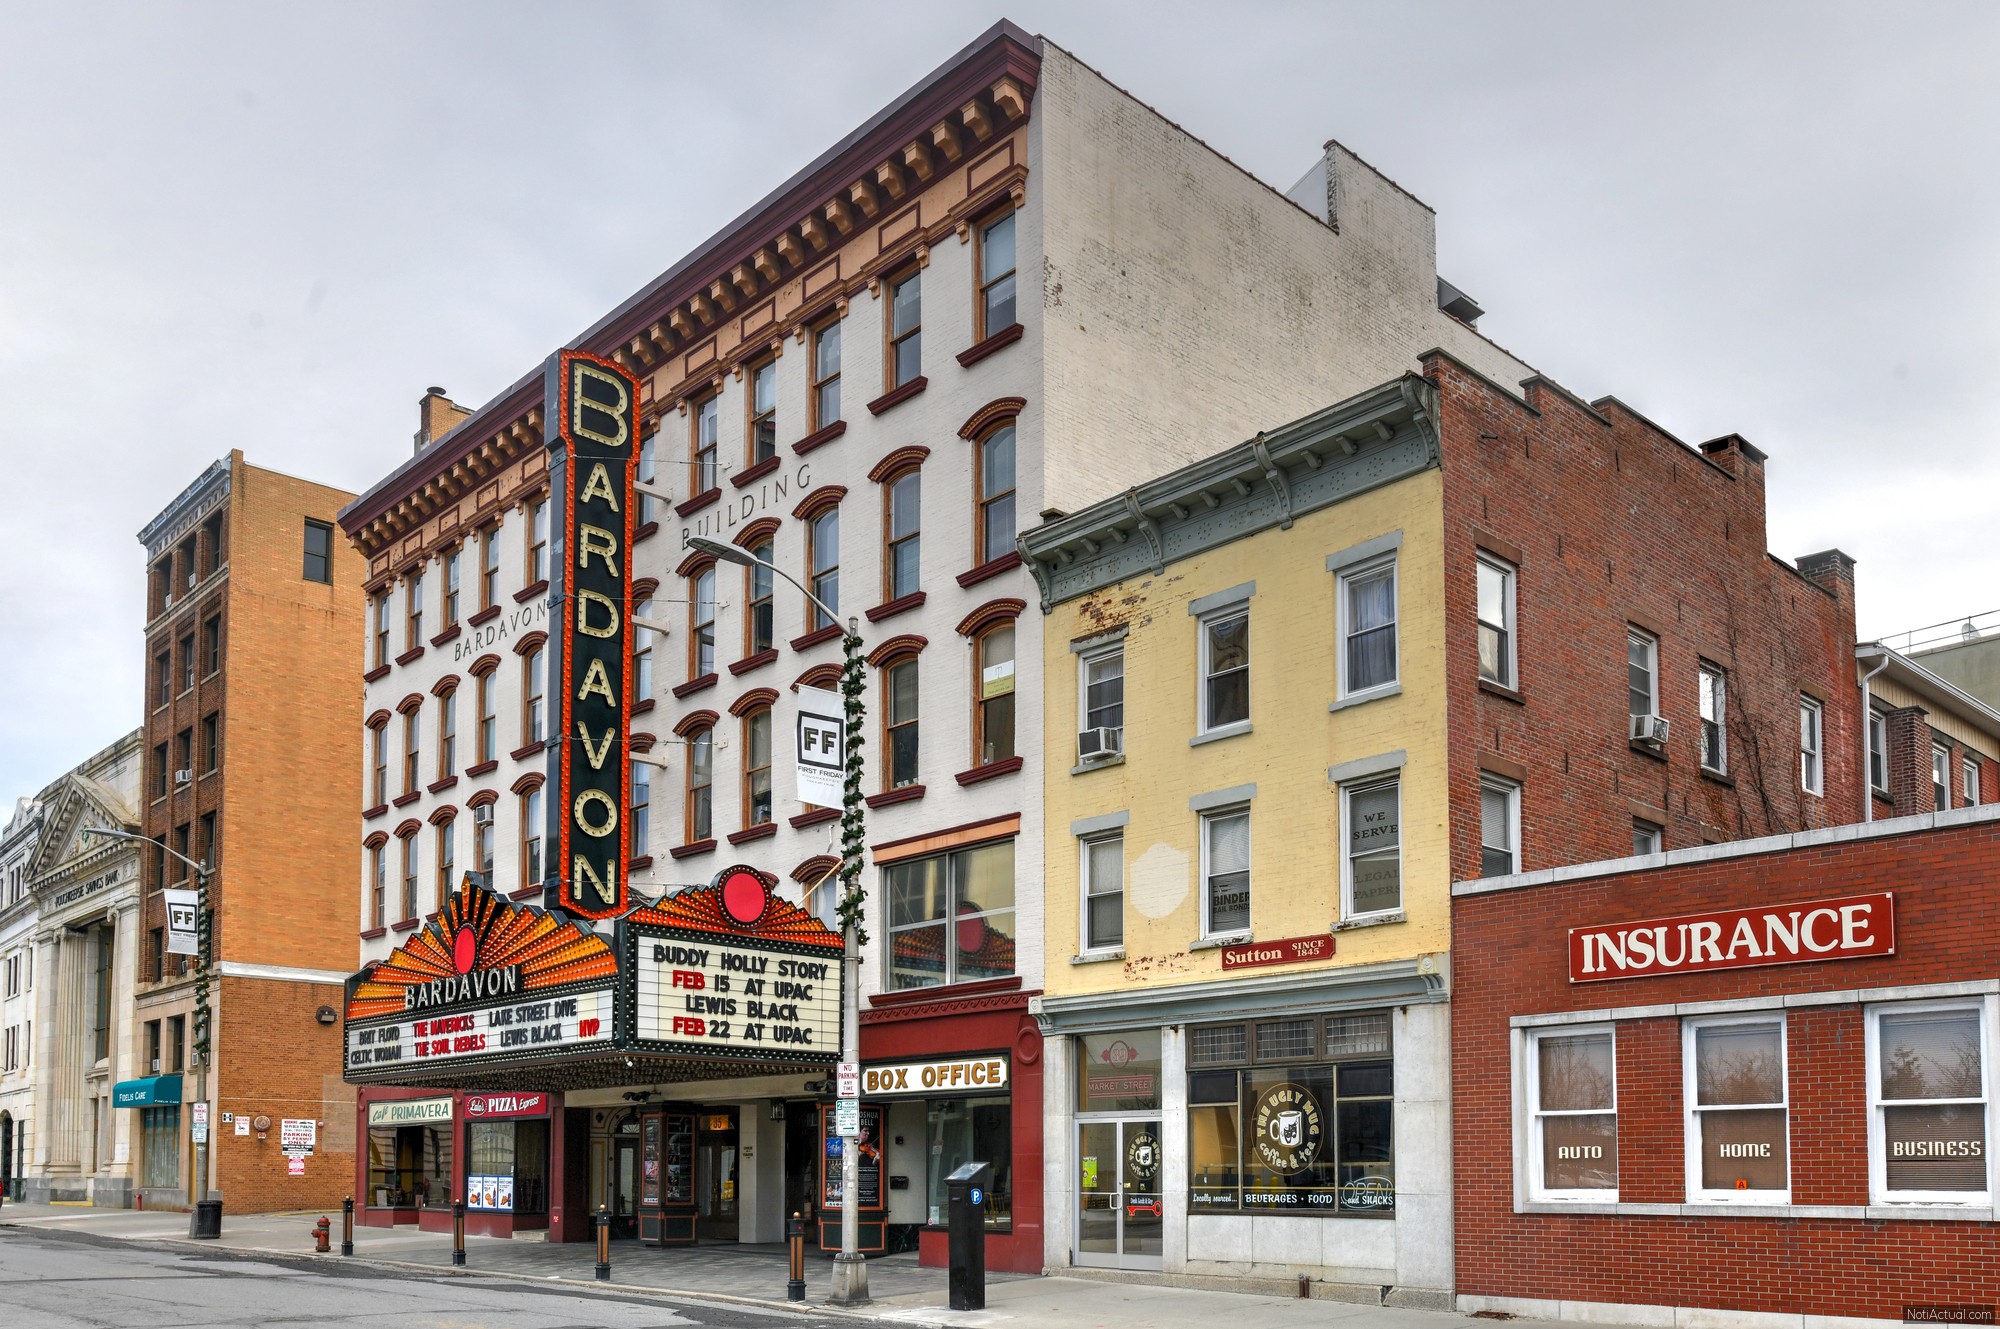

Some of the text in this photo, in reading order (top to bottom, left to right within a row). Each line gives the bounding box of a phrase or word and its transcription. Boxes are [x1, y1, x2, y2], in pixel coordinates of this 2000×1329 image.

[682, 464, 810, 550] BUILDING
[454, 598, 546, 662] BARDAVON
[574, 363, 628, 904] BARDAVON
[804, 726, 837, 754] FF
[798, 766, 844, 779] FIRST FRIDAY
[1364, 812, 1386, 822] WE
[1353, 824, 1398, 840] SERVE
[173, 910, 194, 924] FF
[1581, 903, 1875, 974] INSURANCE
[654, 944, 828, 980] BUDDY HOLLY STORY
[1225, 940, 1324, 965] Sutton SINCE
[1297, 948, 1320, 957] 1845
[405, 964, 516, 1010] BARDAVON
[672, 970, 812, 1001] FEB 15 AT UPAC
[490, 998, 577, 1027] LAKE STREET DIVE
[686, 994, 799, 1021] LEWIS BLACK
[360, 1026, 400, 1046] BRIT FLOYD
[413, 1014, 474, 1038] THE MAVERICKS
[500, 1023, 562, 1048] LEWIS BLACK
[673, 1016, 812, 1044] FEB 22 AT UPAC
[351, 1045, 402, 1064] CELTIC WOMAN
[414, 1034, 486, 1057] THE SOUL REBELS
[867, 1062, 1000, 1091] BOX OFFICE
[1088, 1080, 1154, 1090] MARKET STREET
[119, 1092, 147, 1102] FIDELIS CARE
[488, 1097, 517, 1112] PIZZA
[519, 1096, 540, 1111] Express
[837, 1102, 842, 1110] 2
[392, 1102, 449, 1120] PRIMAVERA
[1257, 1090, 1320, 1137] THE UGLY MUG
[1135, 1136, 1152, 1145] UGLY
[1152, 1142, 1160, 1160] MUG
[1260, 1142, 1316, 1169] coffee & tea
[1558, 1146, 1602, 1159] AUTO
[1720, 1144, 1771, 1158] HOME
[1893, 1141, 1981, 1156] BUSINESS
[1130, 1162, 1144, 1177] coffee
[1193, 1193, 1211, 1204] Locally
[1245, 1194, 1332, 1204] BEVERAGES FOOD
[1343, 1182, 1390, 1201] OPEN
[1362, 1196, 1393, 1205] SNACKS
